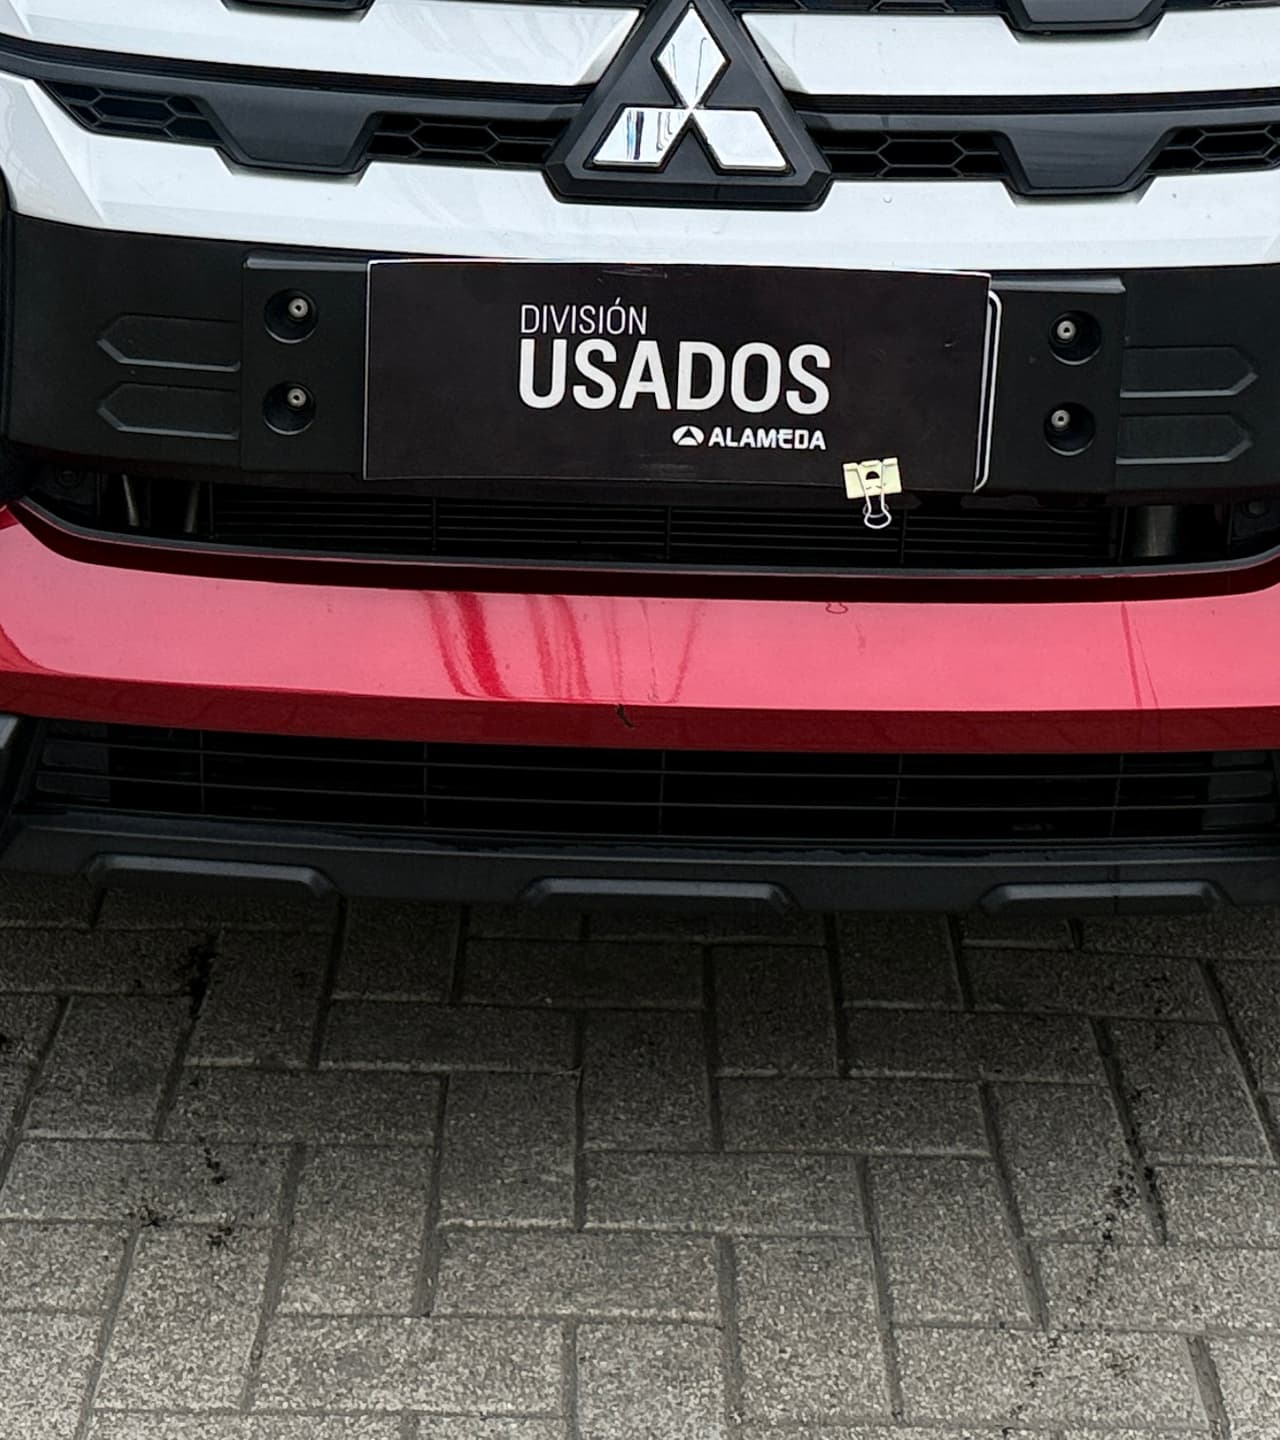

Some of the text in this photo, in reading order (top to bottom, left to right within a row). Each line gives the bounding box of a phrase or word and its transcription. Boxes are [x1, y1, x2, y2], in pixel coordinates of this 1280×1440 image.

[520, 297, 647, 336] DIVISIÓN
[518, 338, 831, 415] USADOS
[708, 426, 827, 450] ALAMEDA
